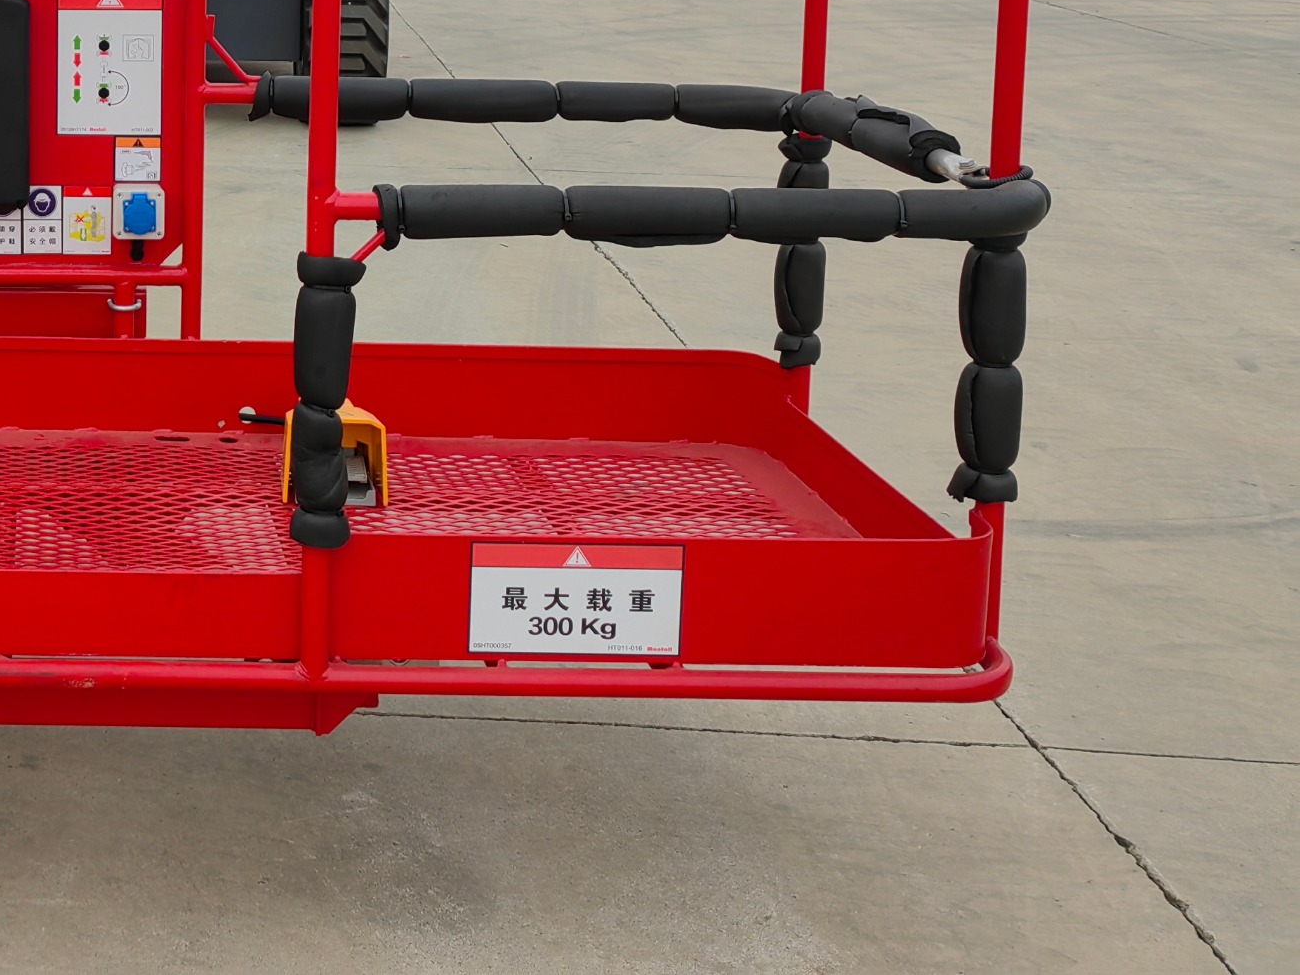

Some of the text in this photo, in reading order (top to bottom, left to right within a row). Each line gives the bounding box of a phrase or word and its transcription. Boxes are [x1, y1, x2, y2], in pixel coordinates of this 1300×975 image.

[28, 225, 57, 233] 必须戴
[28, 237, 57, 245] 安全帽
[501, 586, 656, 613] 最大载重
[528, 616, 617, 640] 300 Kg
